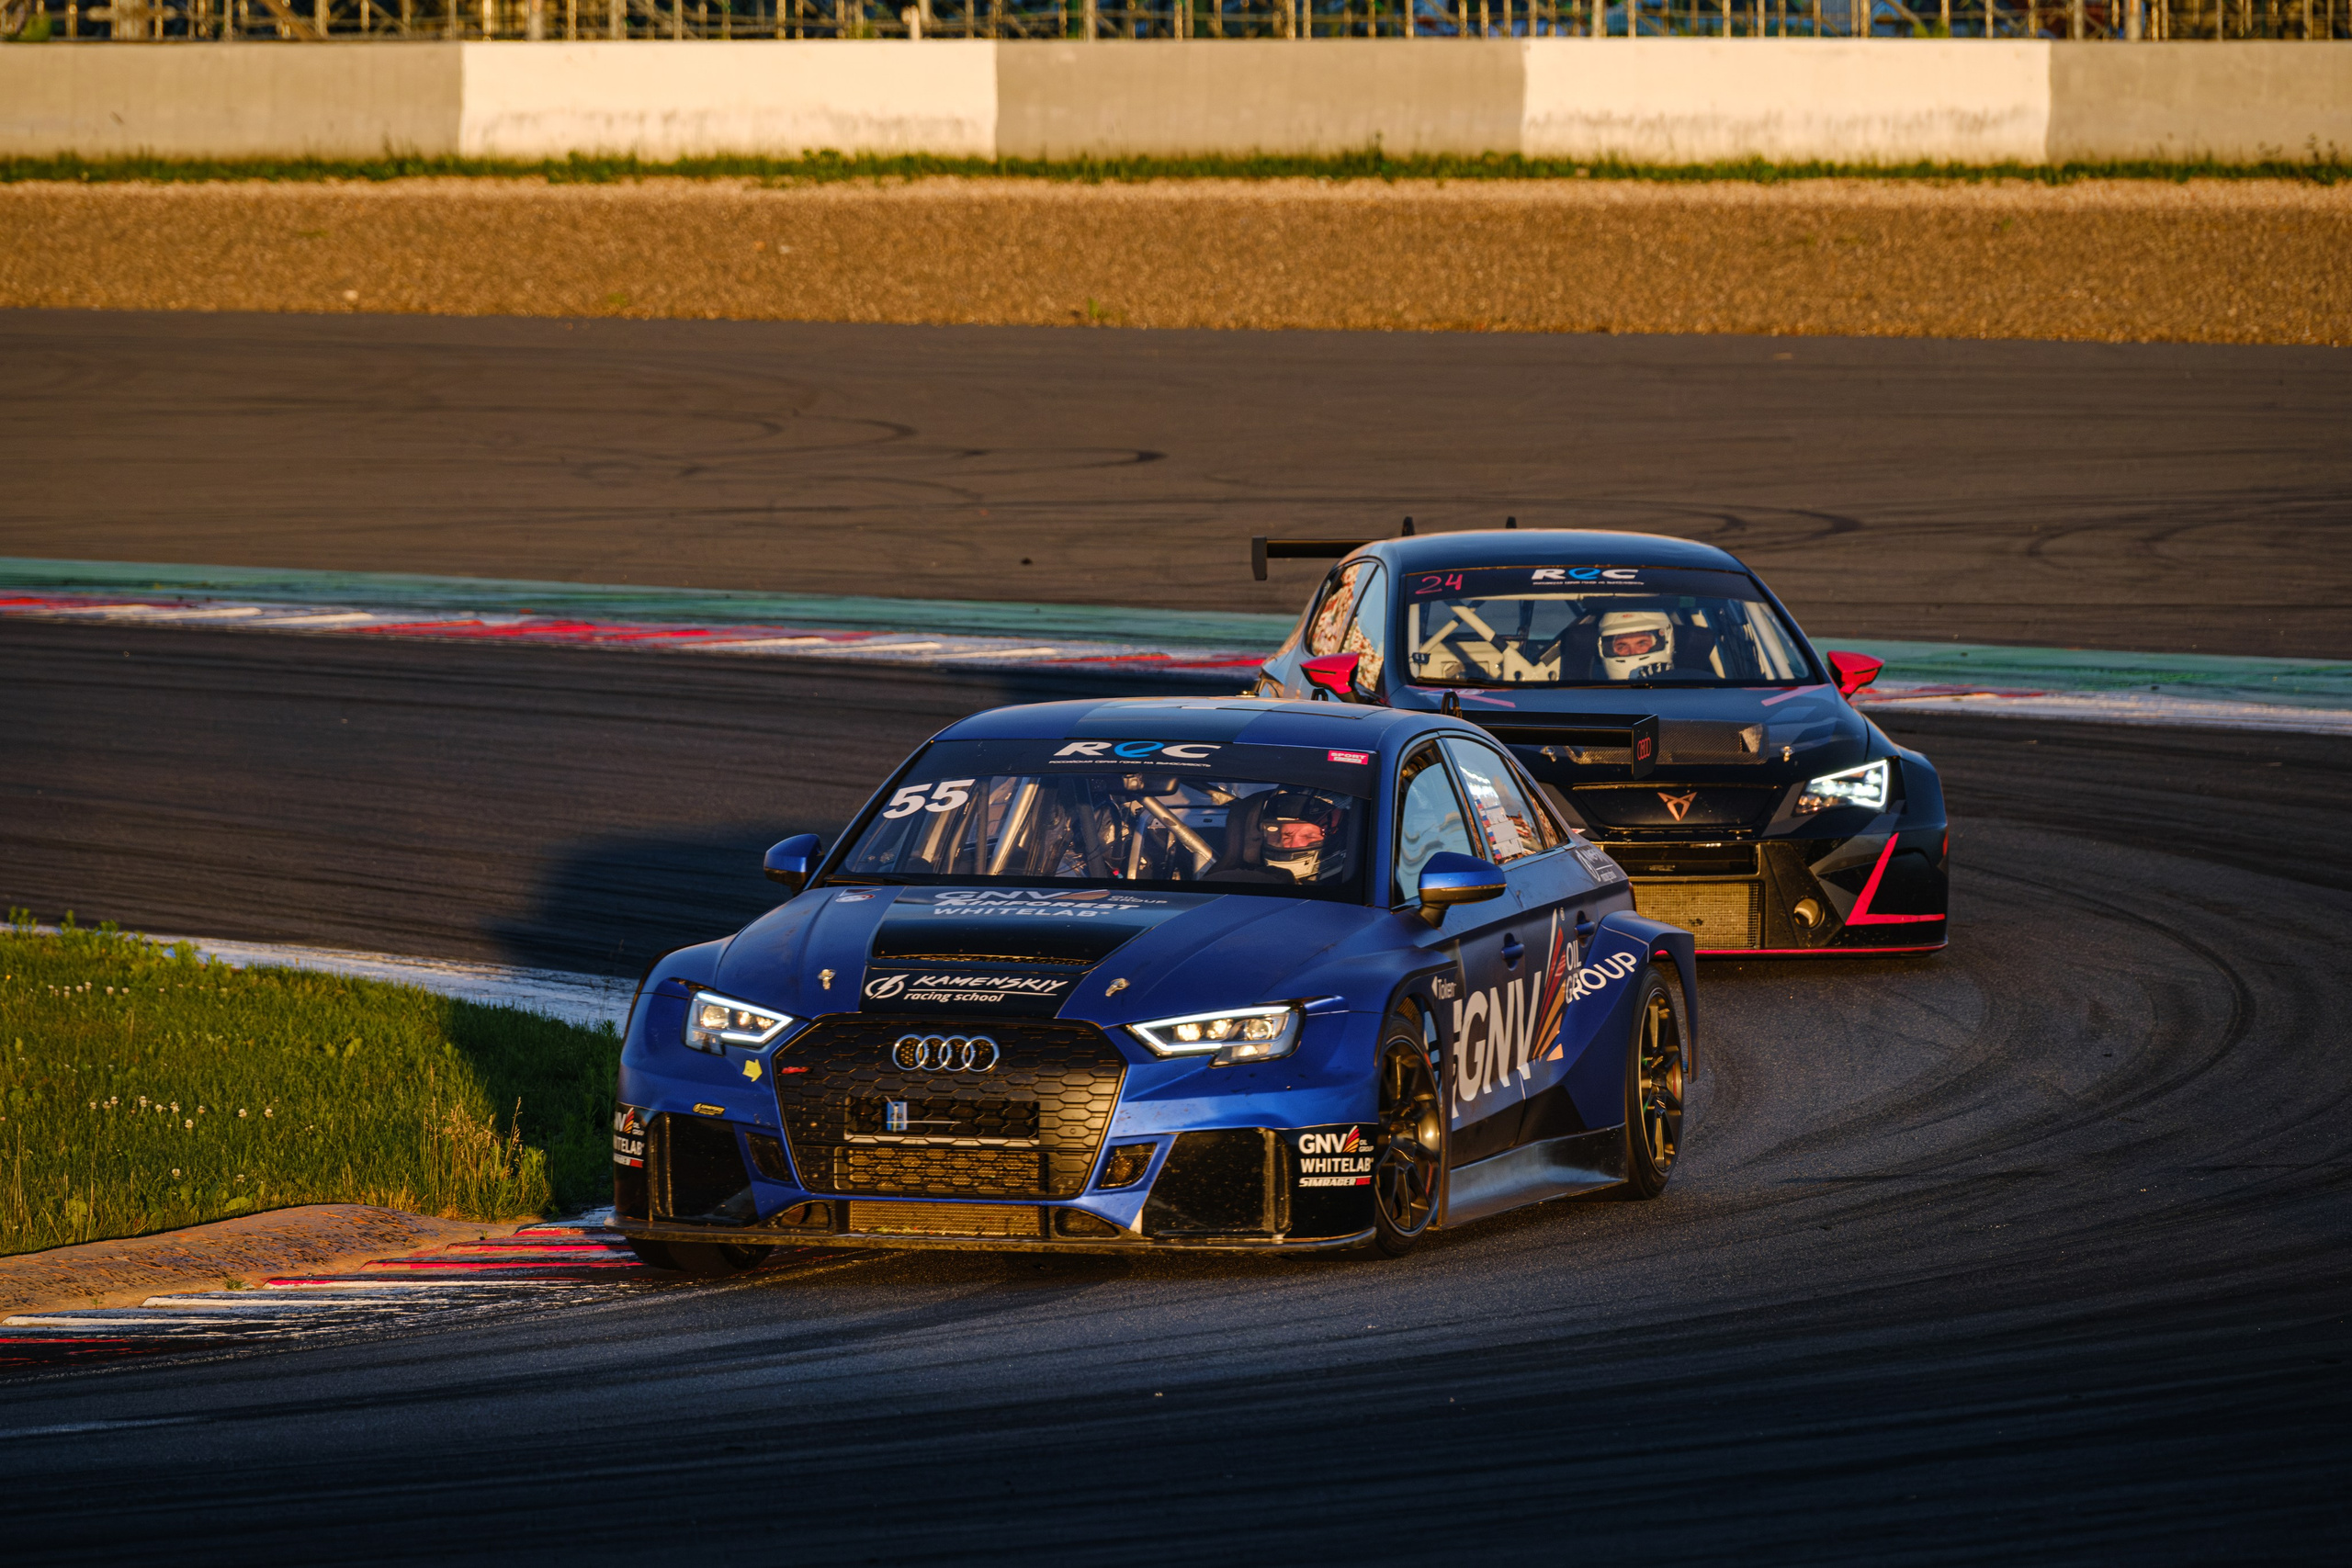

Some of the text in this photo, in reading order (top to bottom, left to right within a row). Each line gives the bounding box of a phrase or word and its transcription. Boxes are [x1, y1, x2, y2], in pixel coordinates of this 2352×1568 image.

[1415, 574, 1463, 594] 24
[883, 779, 976, 818] 55
[933, 890, 1071, 900] GNV
[1566, 939, 1582, 971] OIL
[913, 976, 1069, 993] KAMENSKIY
[1565, 952, 1637, 1005] GROUP
[903, 992, 1005, 1003] racing school
[1459, 971, 1542, 1101] GNV
[1298, 1133, 1348, 1155] GNV
